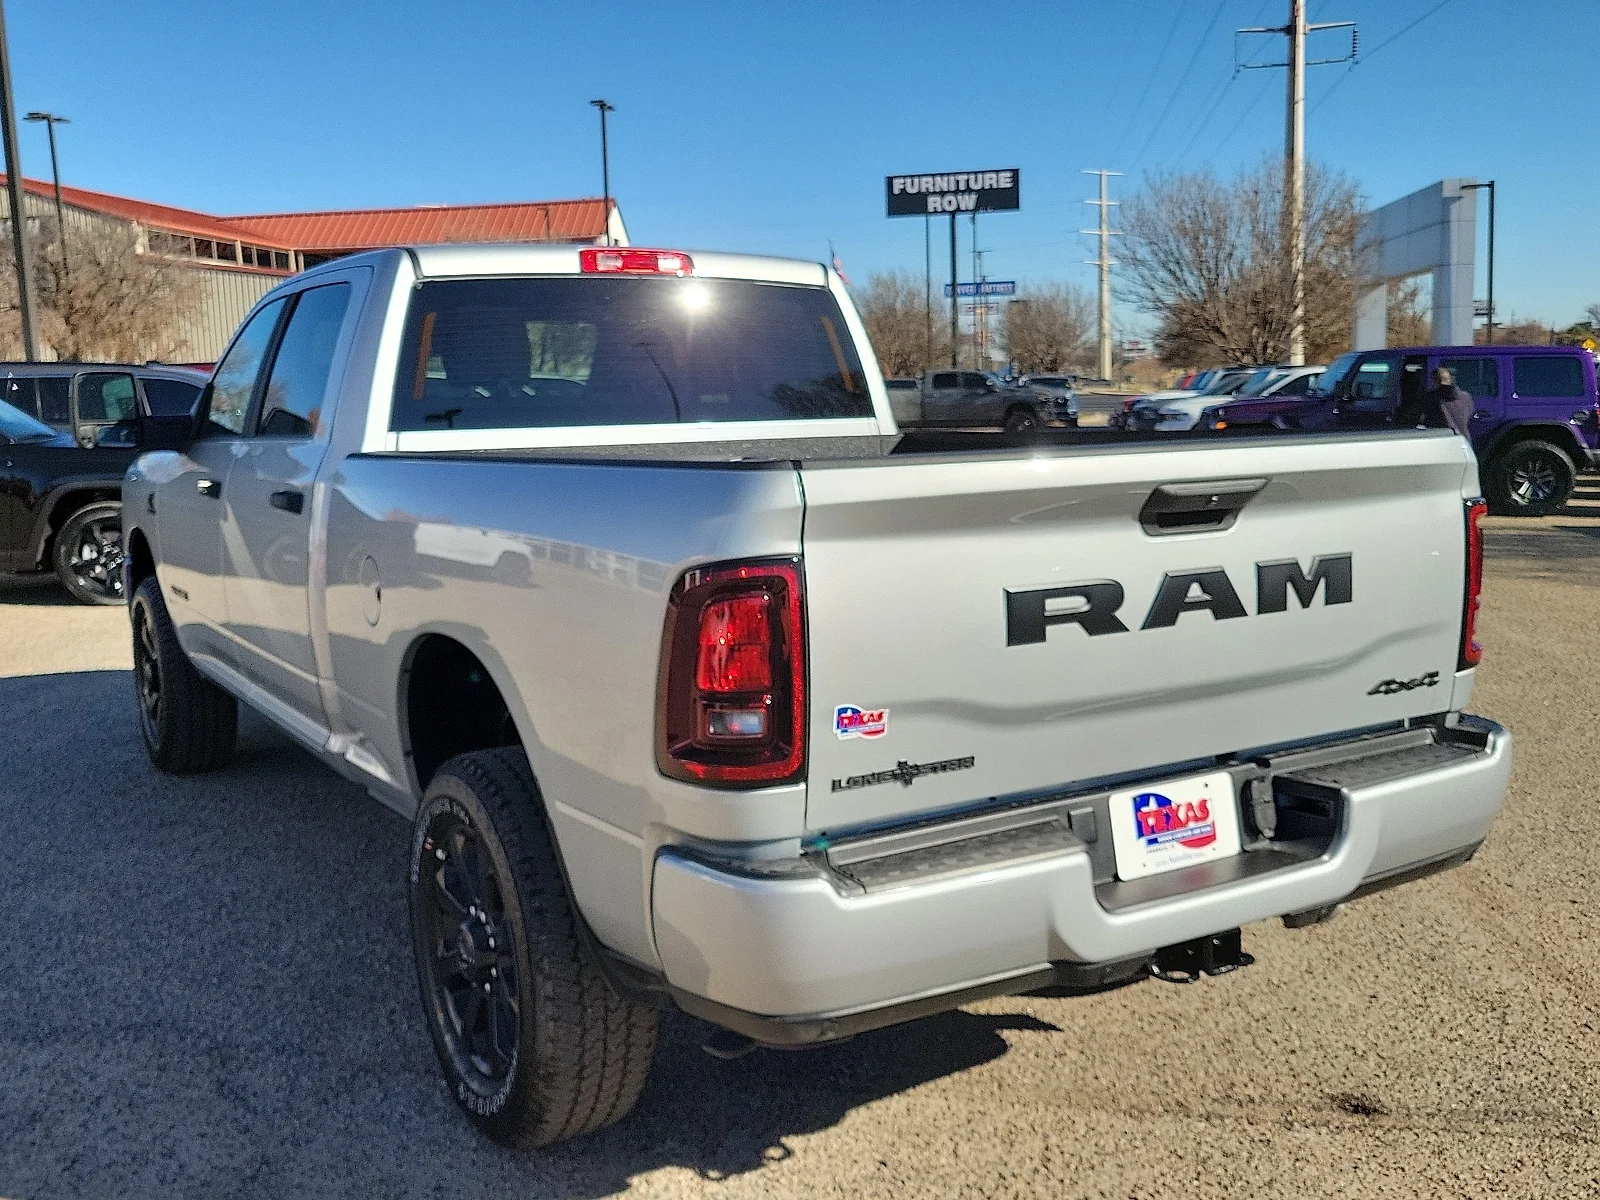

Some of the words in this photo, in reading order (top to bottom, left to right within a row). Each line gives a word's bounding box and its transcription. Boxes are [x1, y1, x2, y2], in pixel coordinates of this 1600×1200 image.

[892, 170, 1015, 195] FURNITURE
[926, 192, 979, 213] ROW
[1003, 552, 1353, 647] RAM
[1137, 799, 1210, 836] TEXAS
